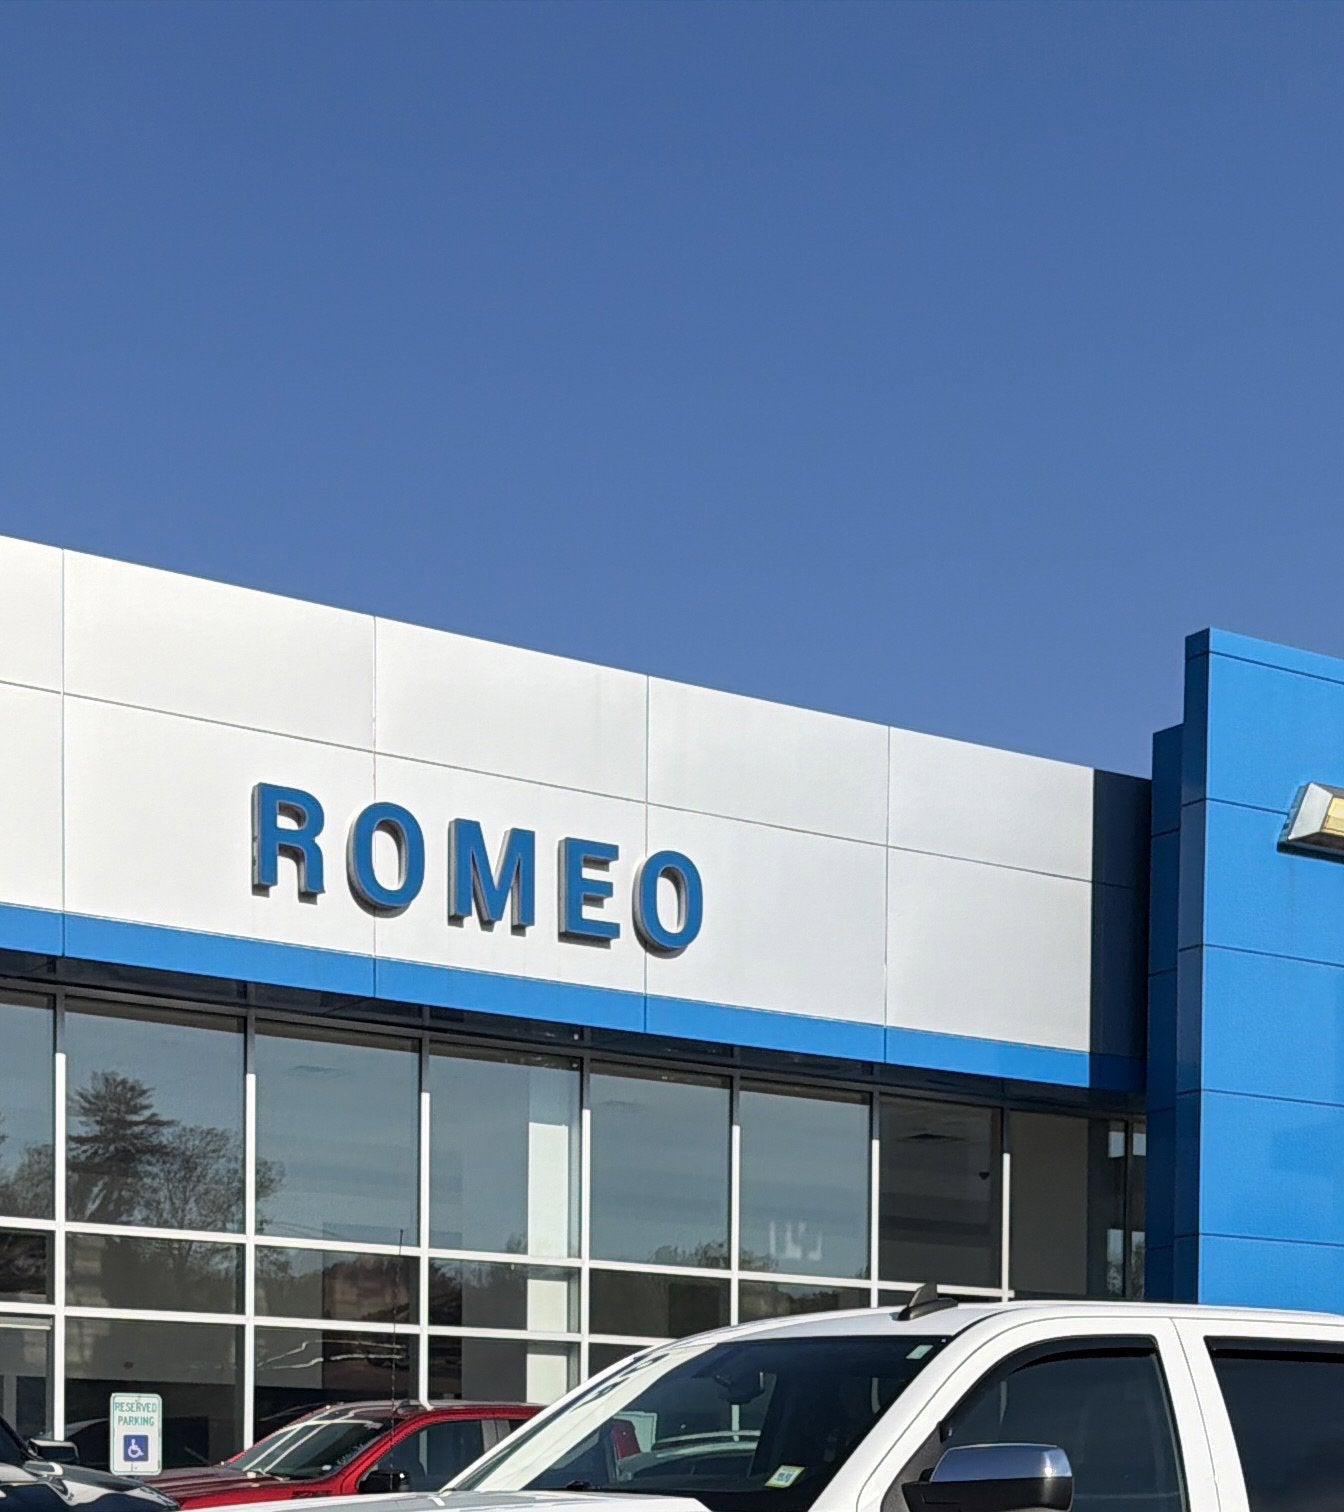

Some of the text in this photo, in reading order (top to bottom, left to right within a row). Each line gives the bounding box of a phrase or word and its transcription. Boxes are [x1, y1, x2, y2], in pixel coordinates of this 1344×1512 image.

[252, 782, 704, 955] ROMEO
[115, 1402, 157, 1412] RESERVED
[118, 1416, 155, 1426] PARKING
